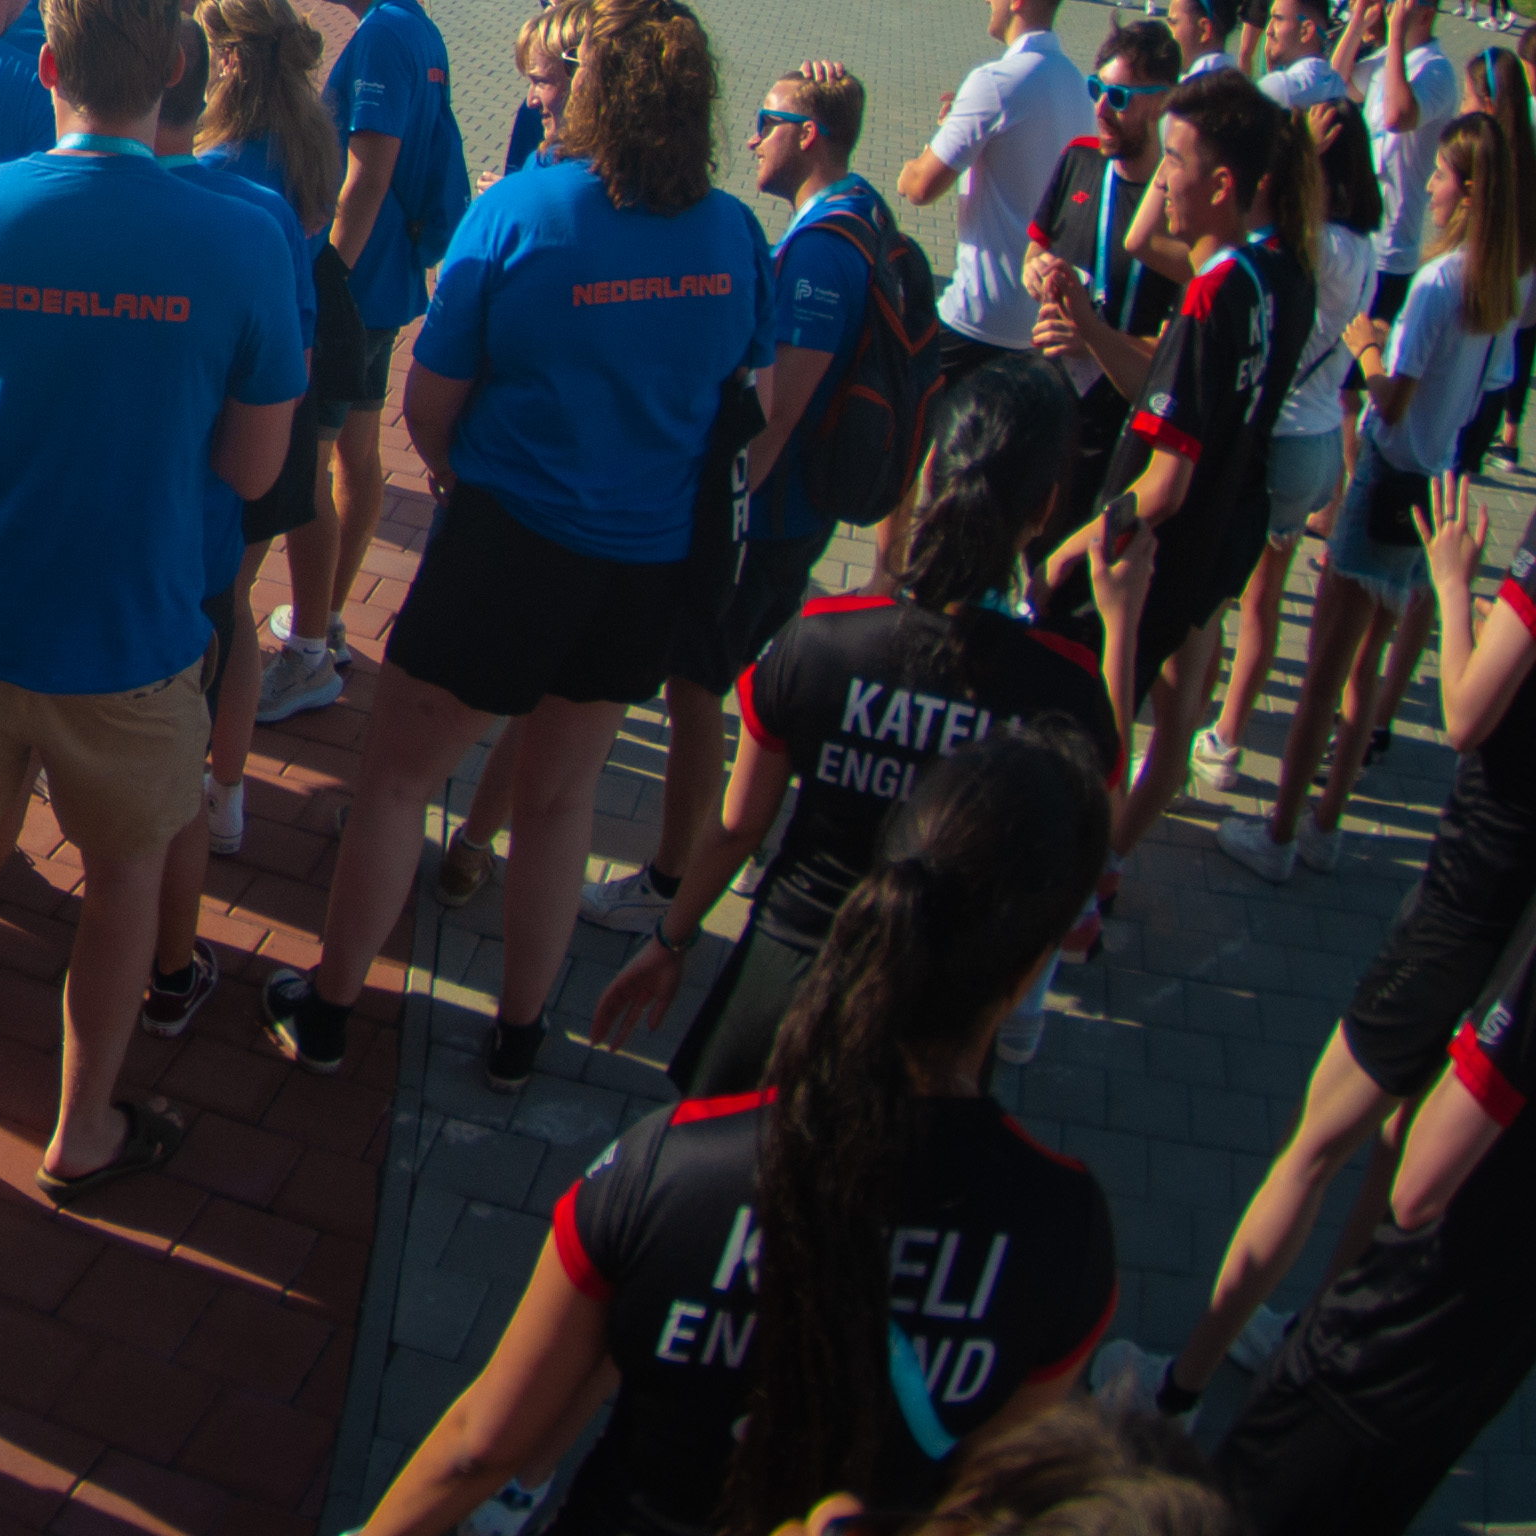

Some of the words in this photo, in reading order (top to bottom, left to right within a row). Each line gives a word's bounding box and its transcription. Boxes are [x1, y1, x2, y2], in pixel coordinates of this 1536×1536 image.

[572, 273, 732, 307] NEDERLAND
[711, 1205, 1010, 1321] KELI
[655, 1300, 998, 1404] ENND
